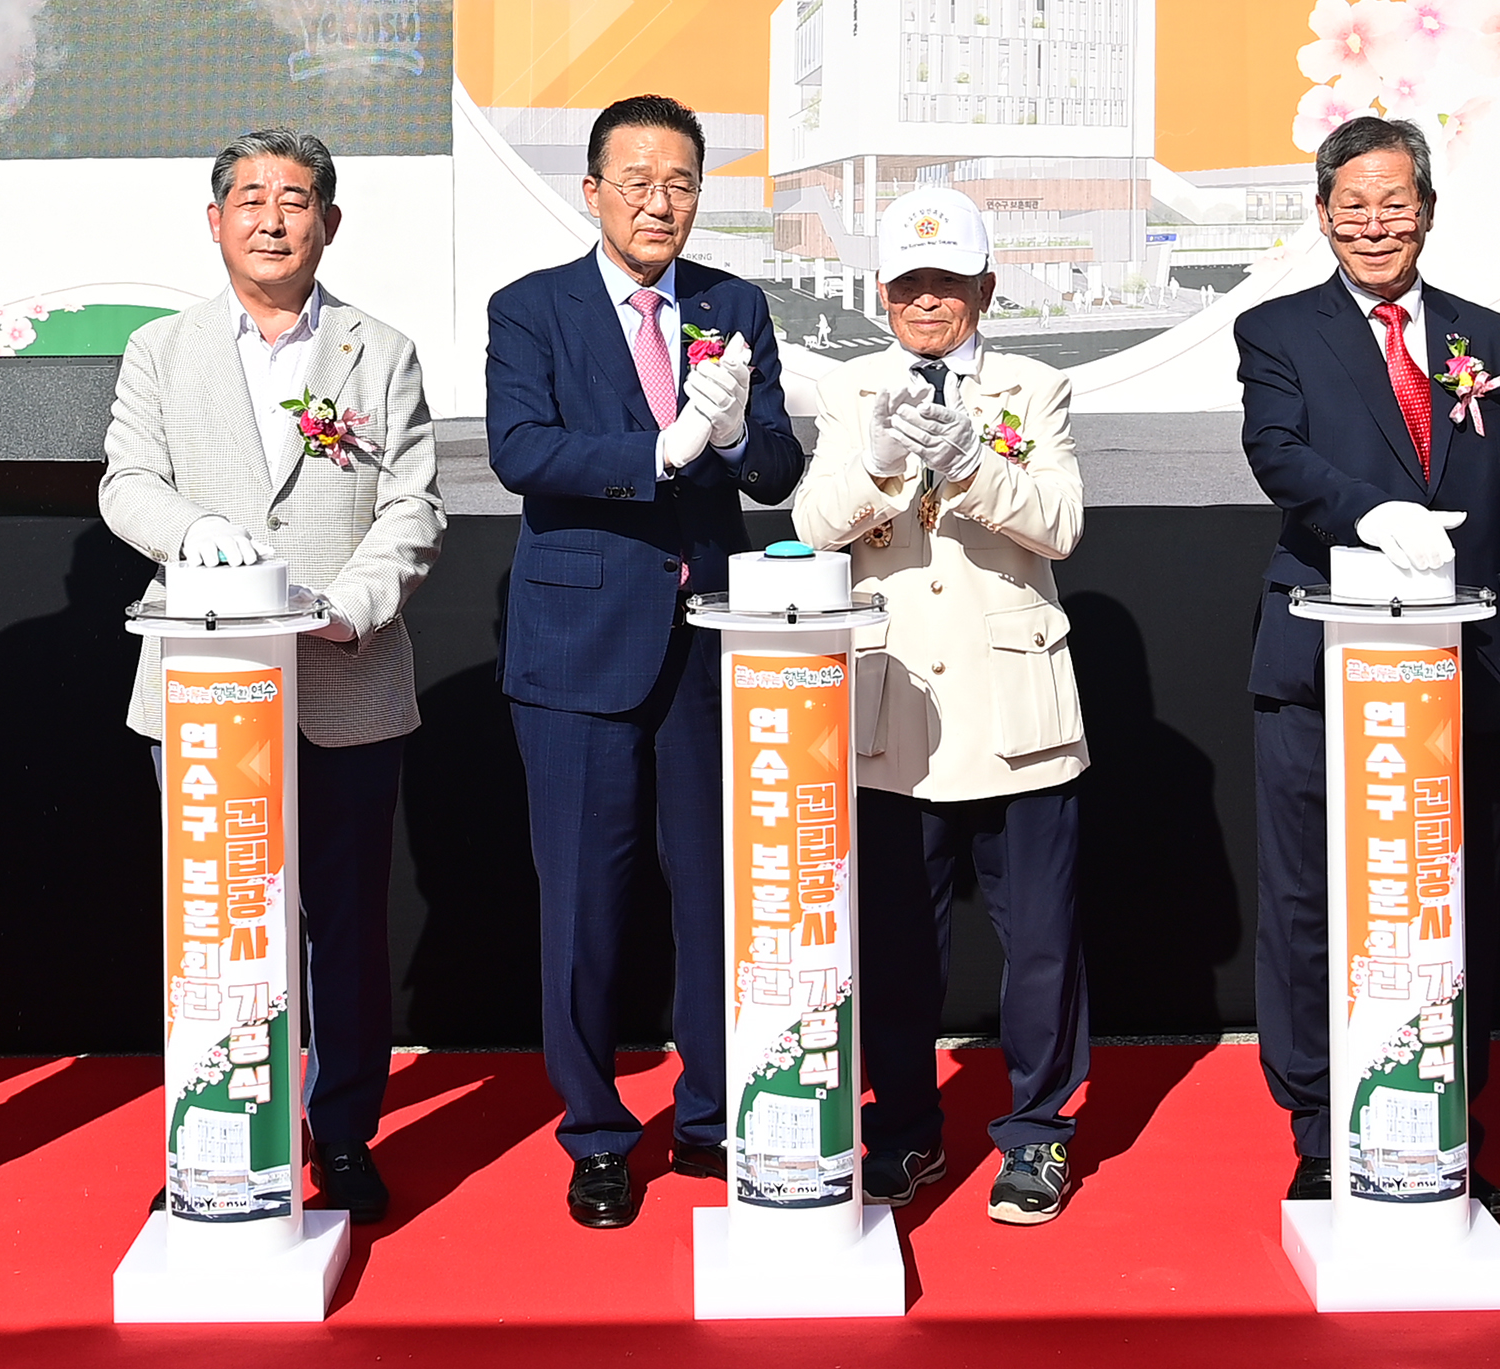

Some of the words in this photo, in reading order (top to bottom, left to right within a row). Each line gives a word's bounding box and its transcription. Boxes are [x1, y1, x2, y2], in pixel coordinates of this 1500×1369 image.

[251, 683, 276, 701] 연수
[821, 668, 842, 686] 연수
[1436, 660, 1455, 678] 연수
[180, 722, 220, 843] 연수구
[748, 706, 789, 828] 연수구
[1363, 701, 1407, 821] 연수구
[225, 797, 268, 962] 건립공사
[797, 782, 837, 947] 건립공사
[1366, 837, 1411, 1001] 보훈회관
[1413, 776, 1453, 941] 건립공사
[182, 857, 223, 1021] 보훈회관
[751, 843, 794, 1007] 보훈회관
[228, 982, 270, 1106] 기공식
[799, 967, 840, 1091] 기공식
[1417, 960, 1456, 1084] 기공식
